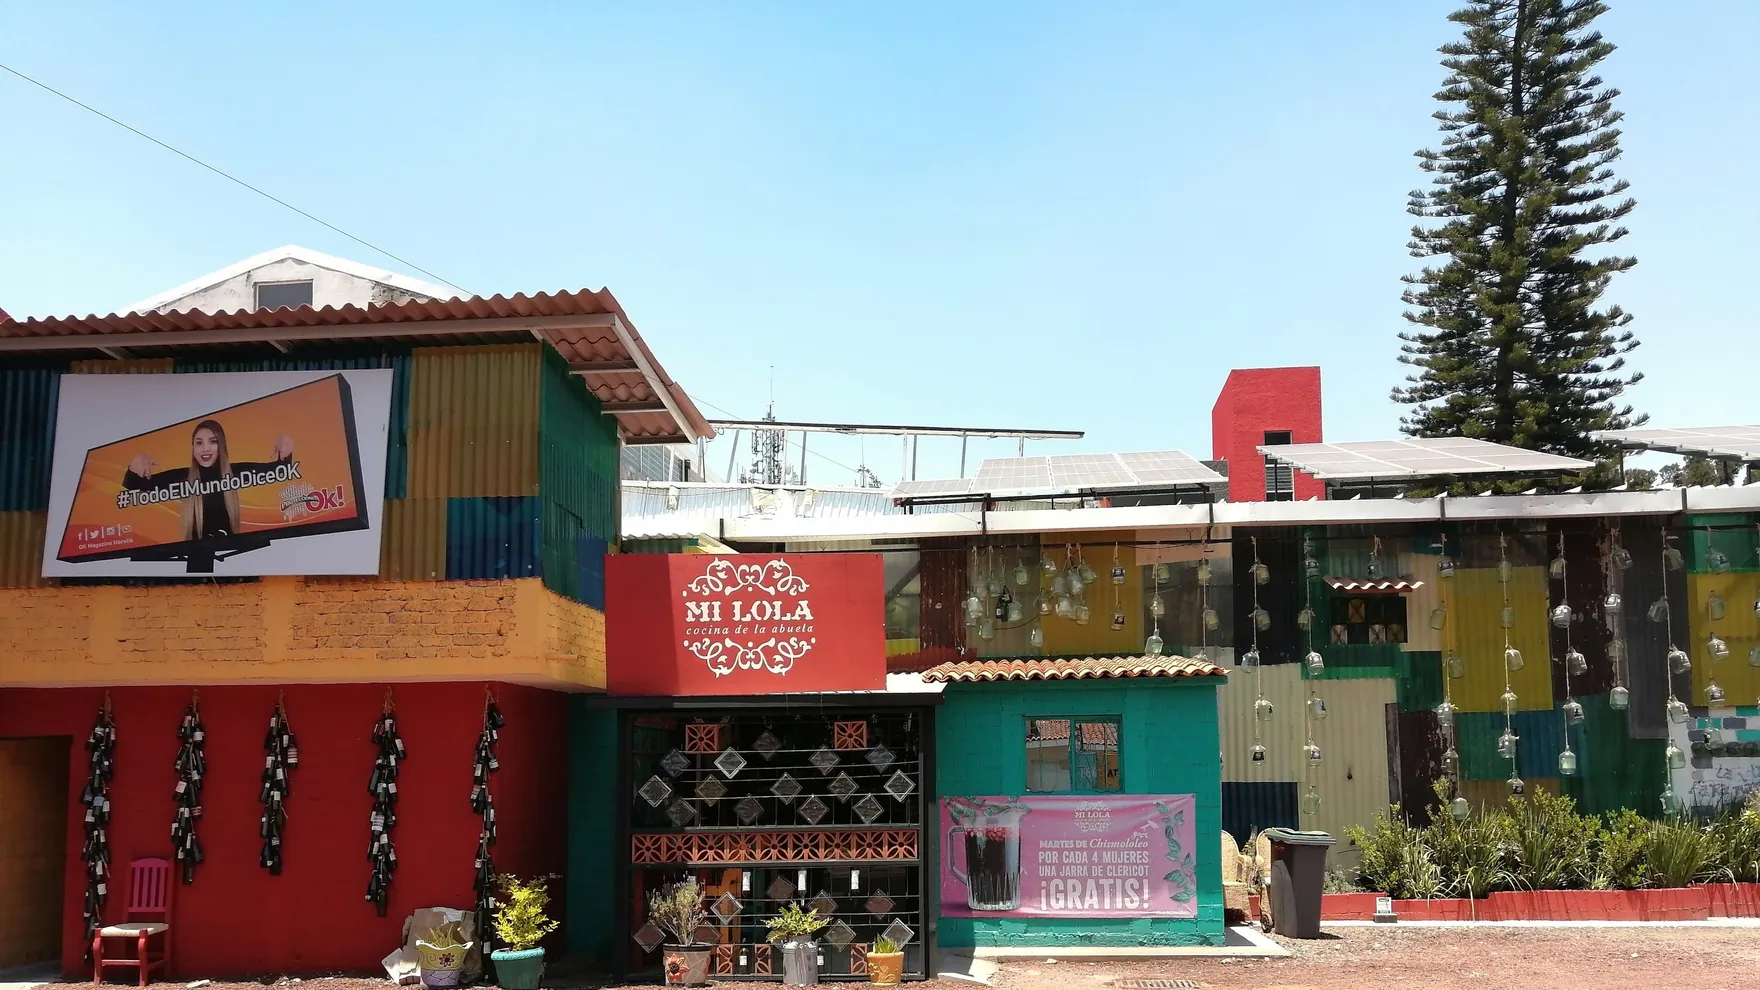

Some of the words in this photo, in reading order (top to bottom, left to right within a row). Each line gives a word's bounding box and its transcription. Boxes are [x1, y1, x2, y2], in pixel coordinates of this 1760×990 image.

[117, 463, 302, 509] #TodoElMundoDiceOK
[685, 601, 722, 622] MI
[732, 600, 814, 621] LOLA
[686, 625, 729, 635] cocina
[735, 624, 748, 635] de
[754, 624, 766, 634] la
[771, 623, 813, 633] abuela
[1040, 840, 1074, 849] MARTES
[1076, 840, 1088, 848] DE
[1089, 838, 1148, 849] Chismololeo
[1038, 851, 1059, 864] POR
[1062, 851, 1088, 864] CADA
[1092, 851, 1099, 864] 4
[1103, 851, 1149, 864] MUJERES
[1039, 866, 1057, 877] UNA
[1060, 866, 1089, 877] JARRA
[1092, 866, 1103, 877] DE
[1107, 865, 1149, 877] CLERICOT
[1040, 878, 1149, 911] ¡GRATIS!
